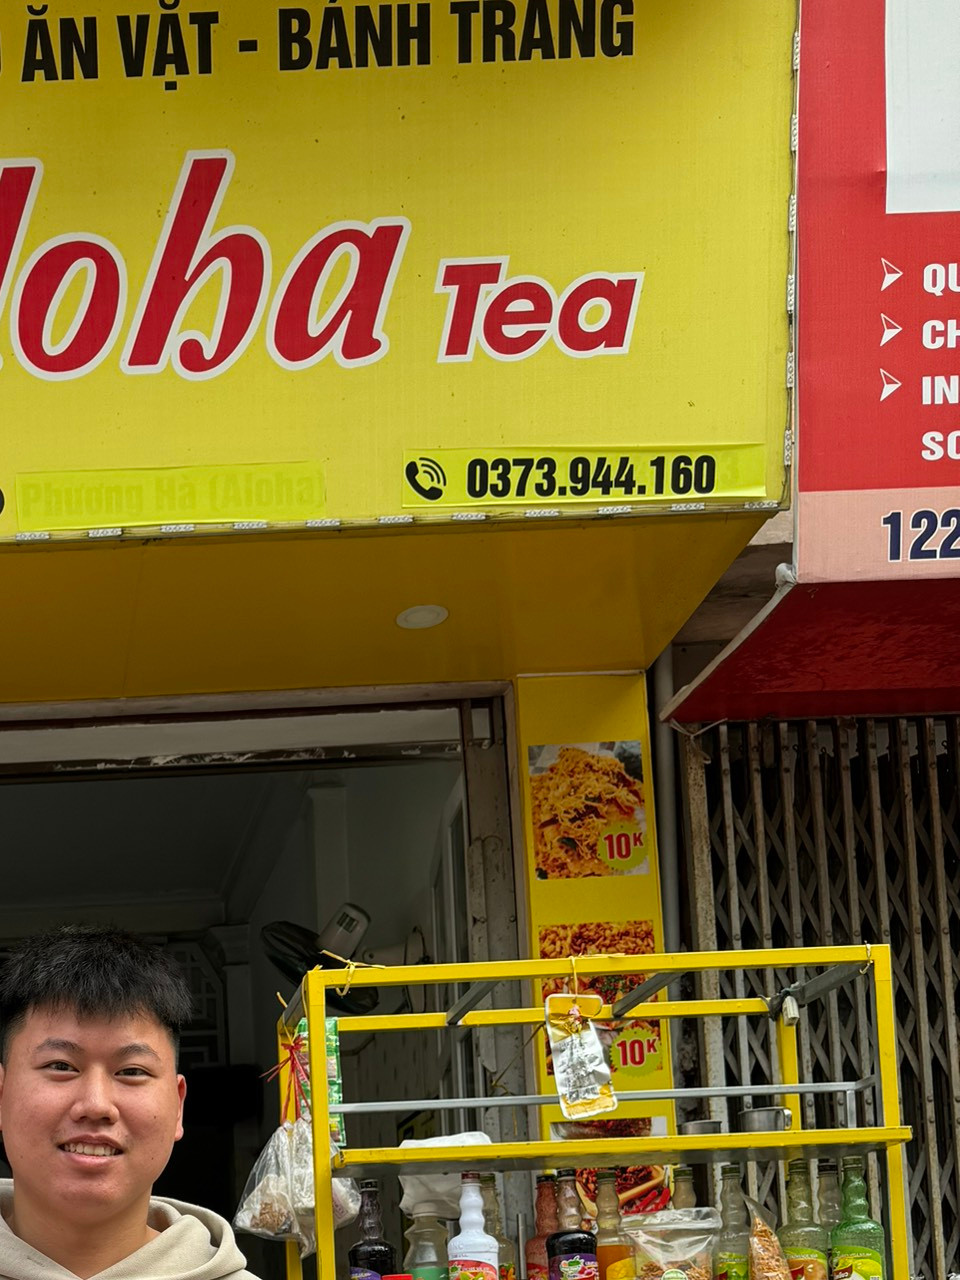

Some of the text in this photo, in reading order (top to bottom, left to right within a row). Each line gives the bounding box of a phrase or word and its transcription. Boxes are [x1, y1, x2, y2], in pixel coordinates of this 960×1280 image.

[21, 3, 98, 82] ĂN
[116, 0, 219, 91] VẶT
[438, 258, 644, 361] Tea
[466, 455, 716, 498] 0373.944.160
[881, 508, 960, 562] 122
[603, 831, 644, 860] 10K
[616, 1037, 658, 1067] 10K
